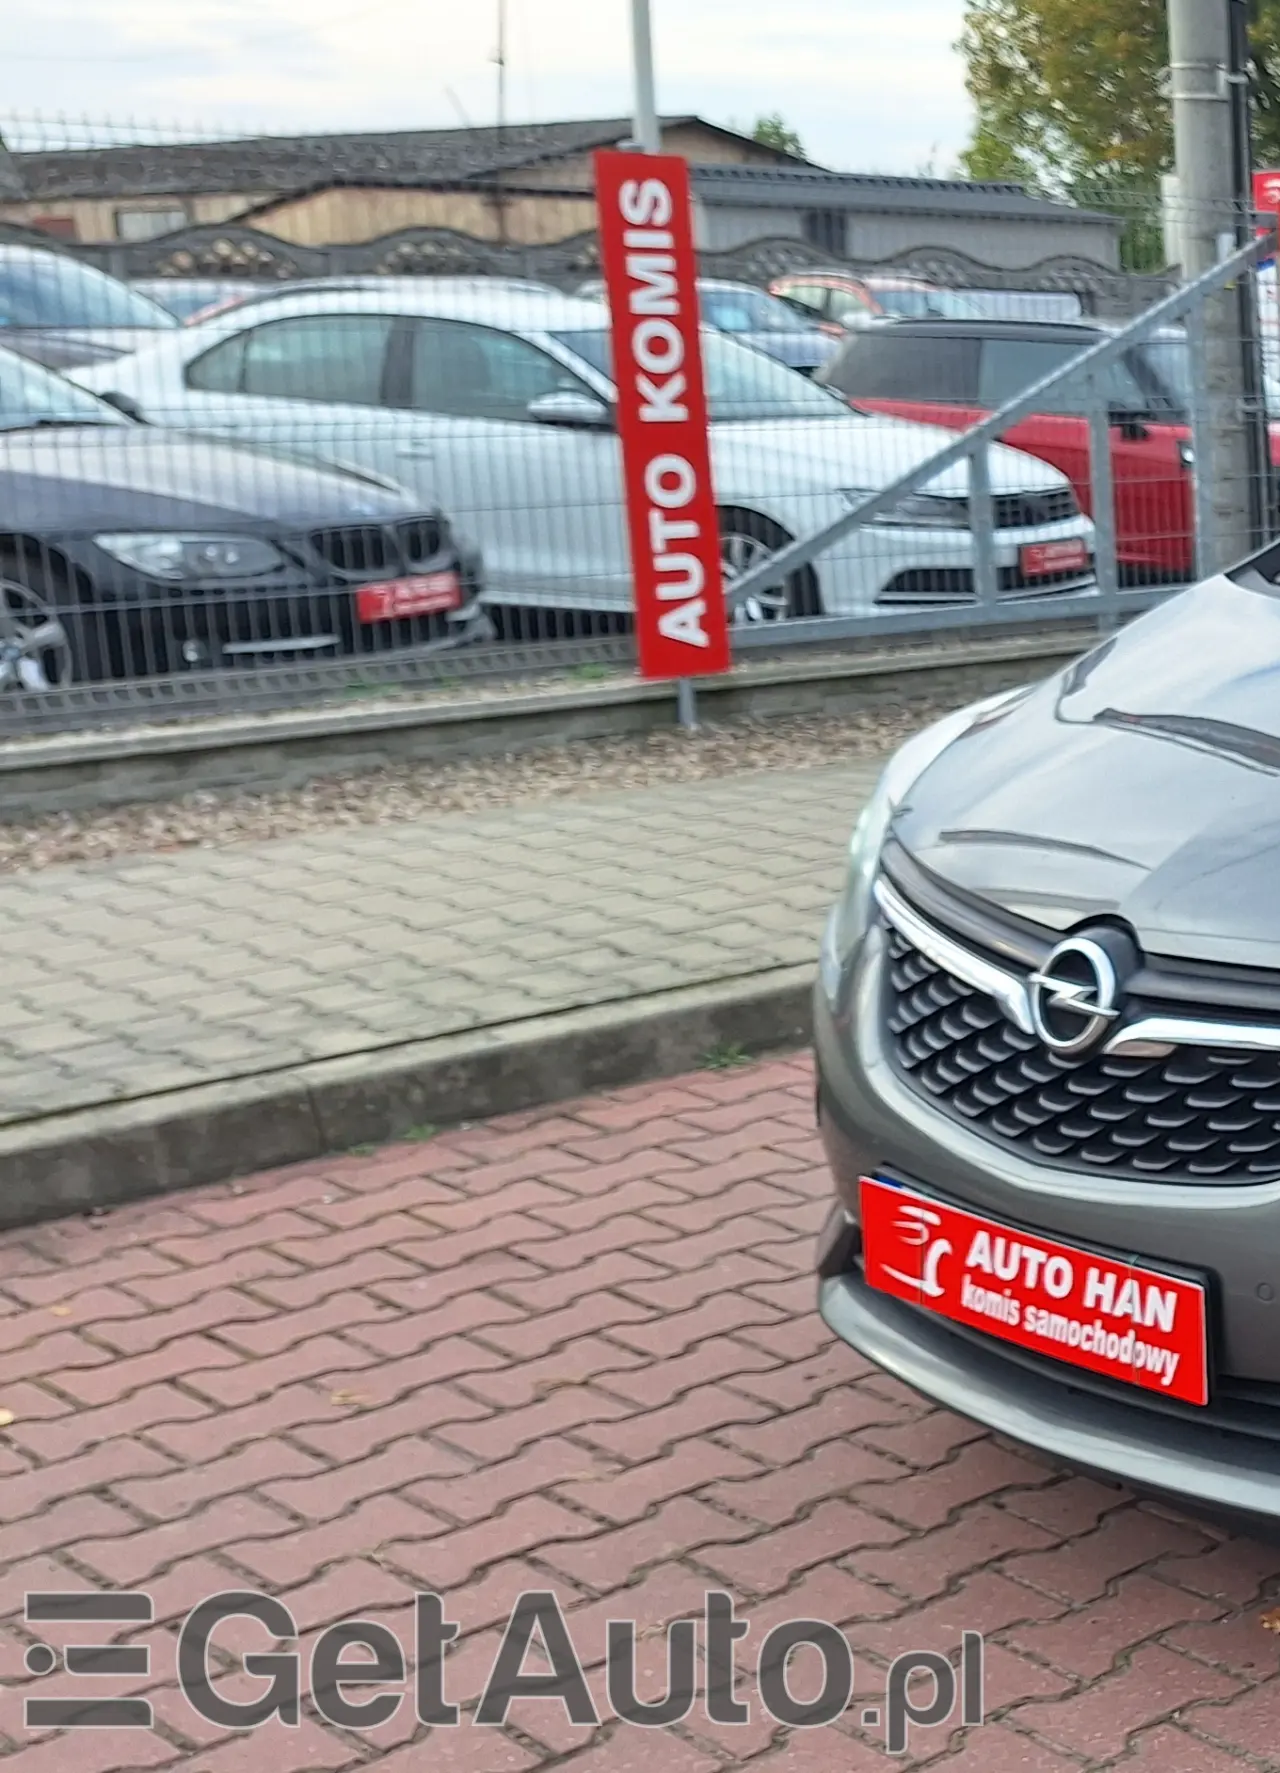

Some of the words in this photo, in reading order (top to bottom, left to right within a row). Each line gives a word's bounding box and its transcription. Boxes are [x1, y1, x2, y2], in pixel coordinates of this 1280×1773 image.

[618, 177, 690, 423] KOMIS
[644, 452, 710, 648] AUTO
[960, 1273, 1021, 1327] komis
[1023, 1304, 1180, 1387] samochodowy
[966, 1230, 1074, 1299] AUTO
[1082, 1267, 1178, 1334] HAN
